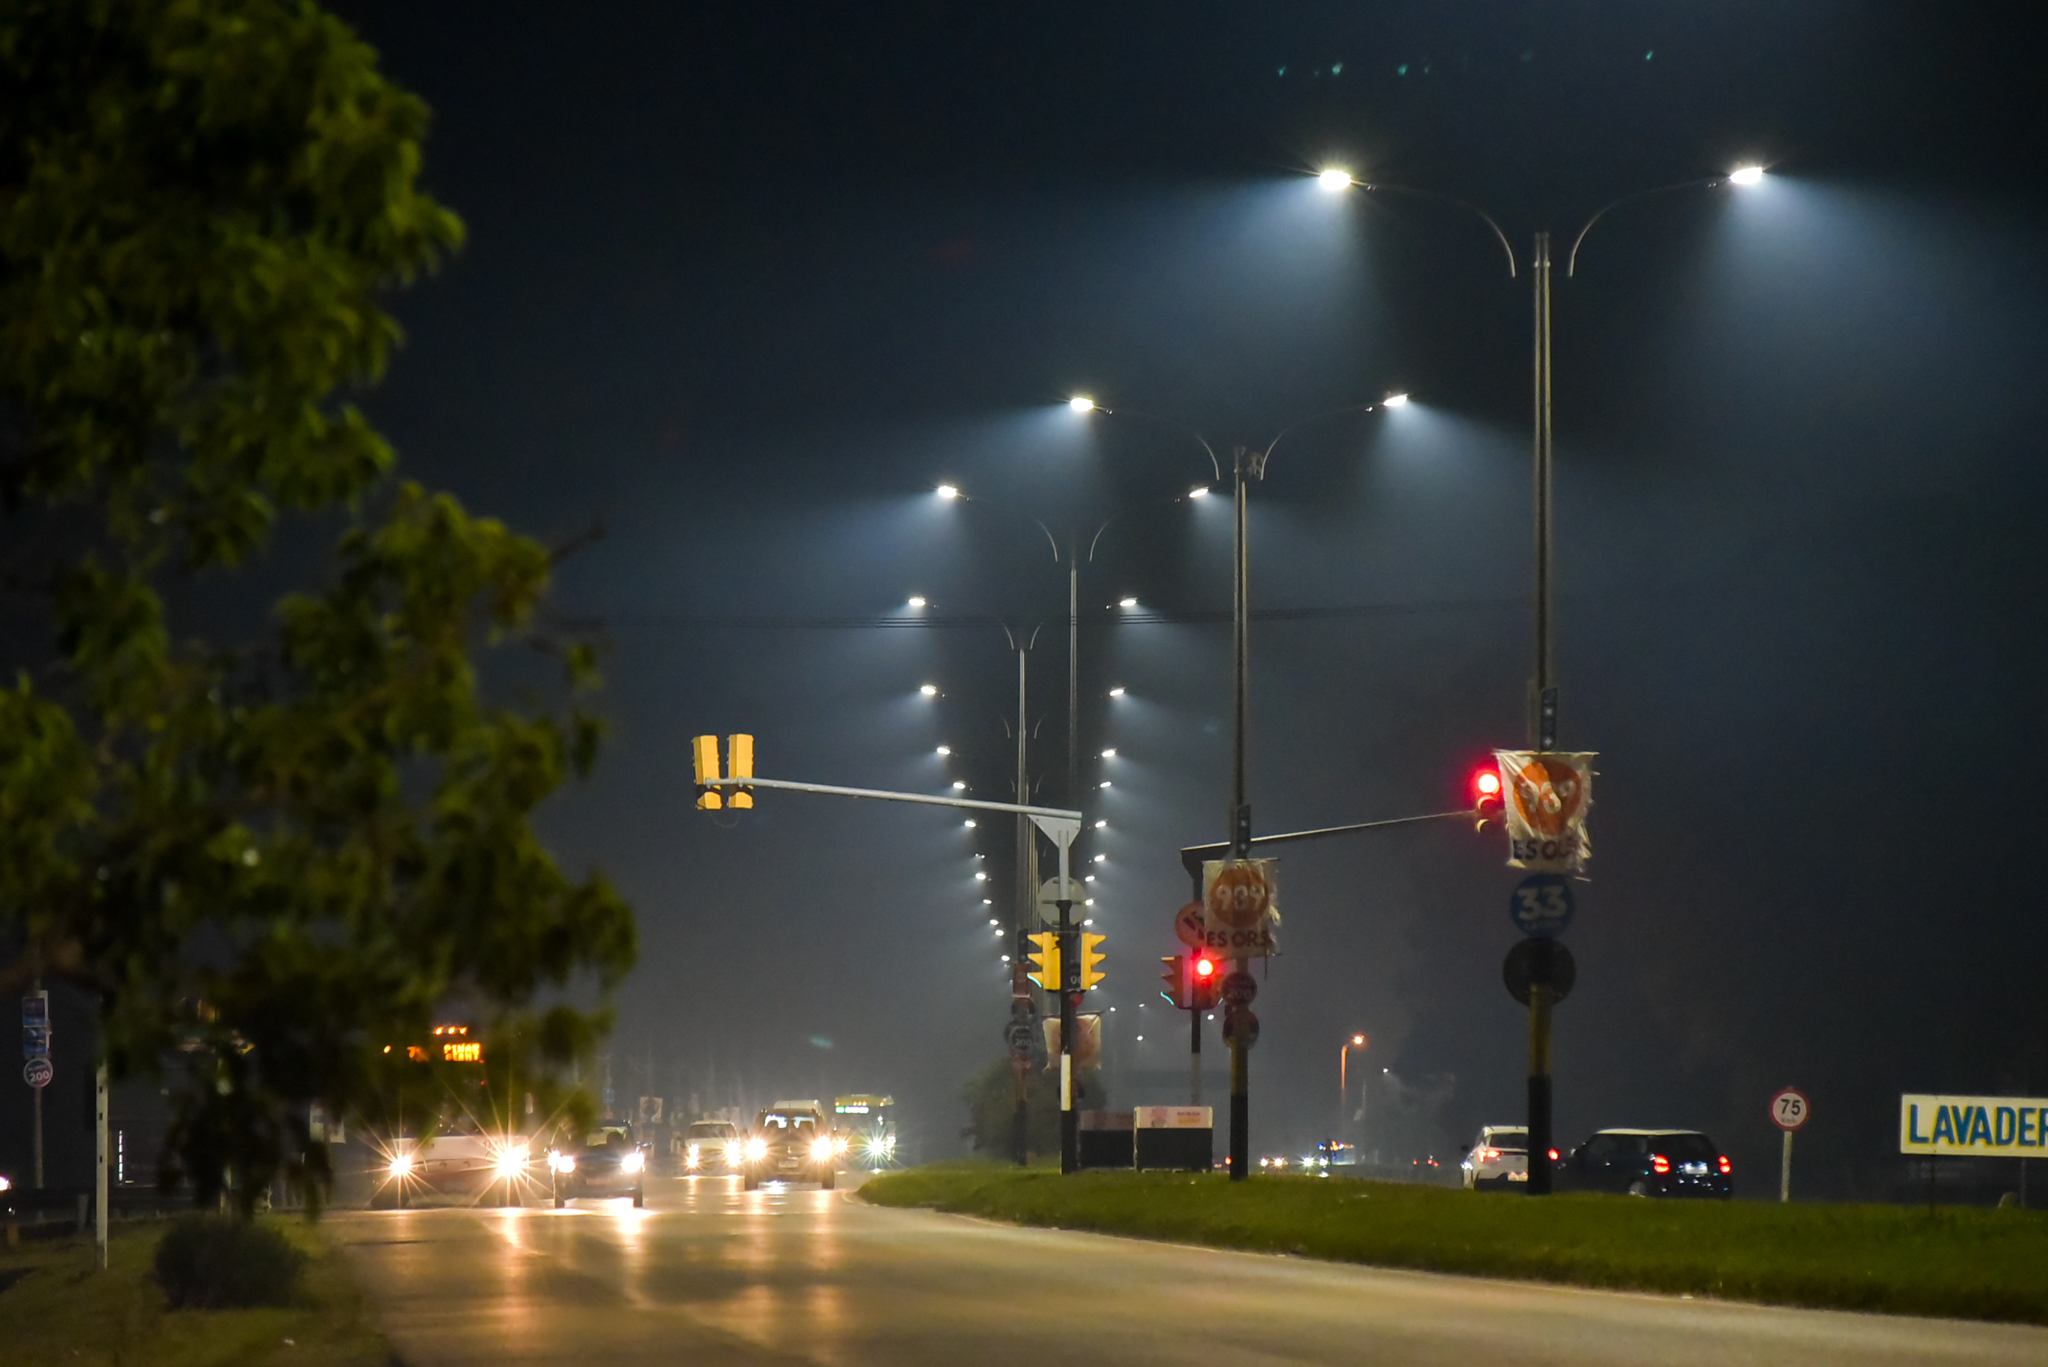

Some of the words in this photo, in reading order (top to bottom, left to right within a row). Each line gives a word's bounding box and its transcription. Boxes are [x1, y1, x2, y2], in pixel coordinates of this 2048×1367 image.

[1512, 838, 1538, 860] ES
[1517, 884, 1568, 921] 33
[1207, 931, 1228, 948] ES
[29, 1070, 50, 1083] 200
[1780, 1098, 1801, 1116] 75
